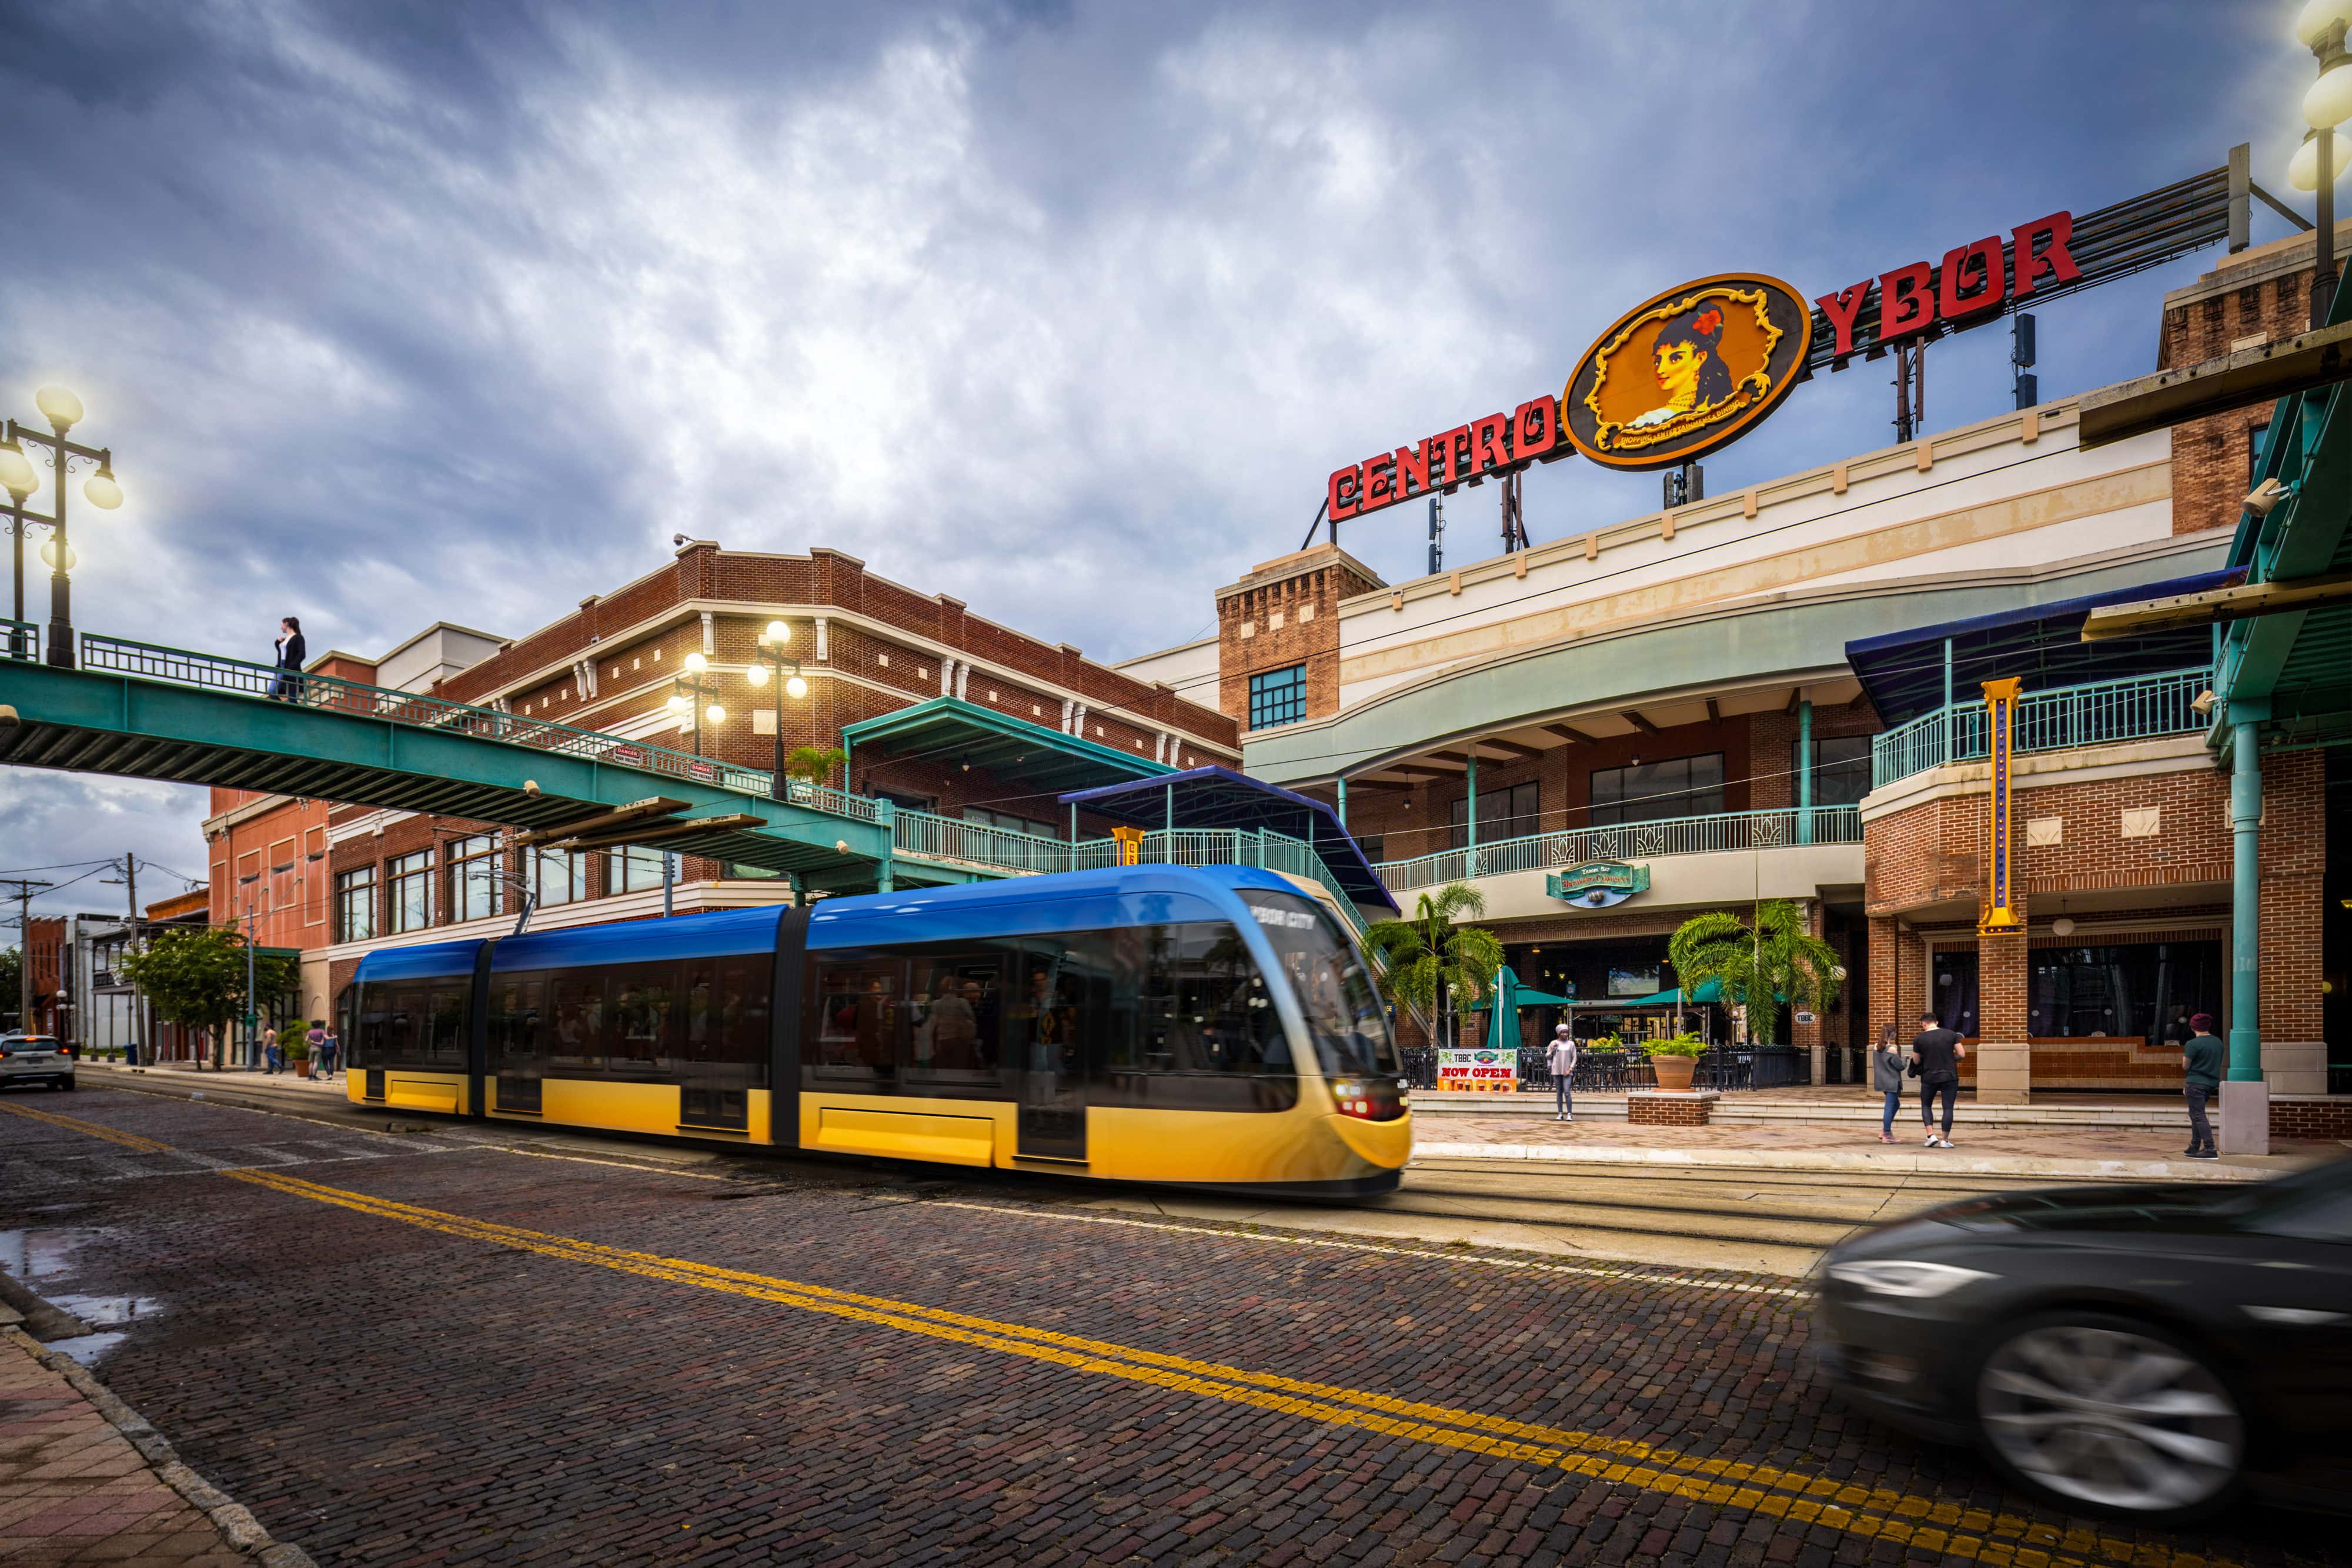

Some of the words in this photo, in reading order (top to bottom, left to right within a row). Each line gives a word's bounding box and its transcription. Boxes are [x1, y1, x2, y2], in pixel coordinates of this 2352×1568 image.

[1328, 394, 1556, 521] CENTRO
[1815, 210, 2083, 356] YBOR
[1620, 434, 1652, 443] SHOPPING
[1716, 399, 1742, 417] DINING
[1286, 912, 1316, 930] CITY
[1454, 1054, 1471, 1062] TBBC
[1442, 1067, 1470, 1077] NOW
[1472, 1068, 1512, 1078] OPEN
